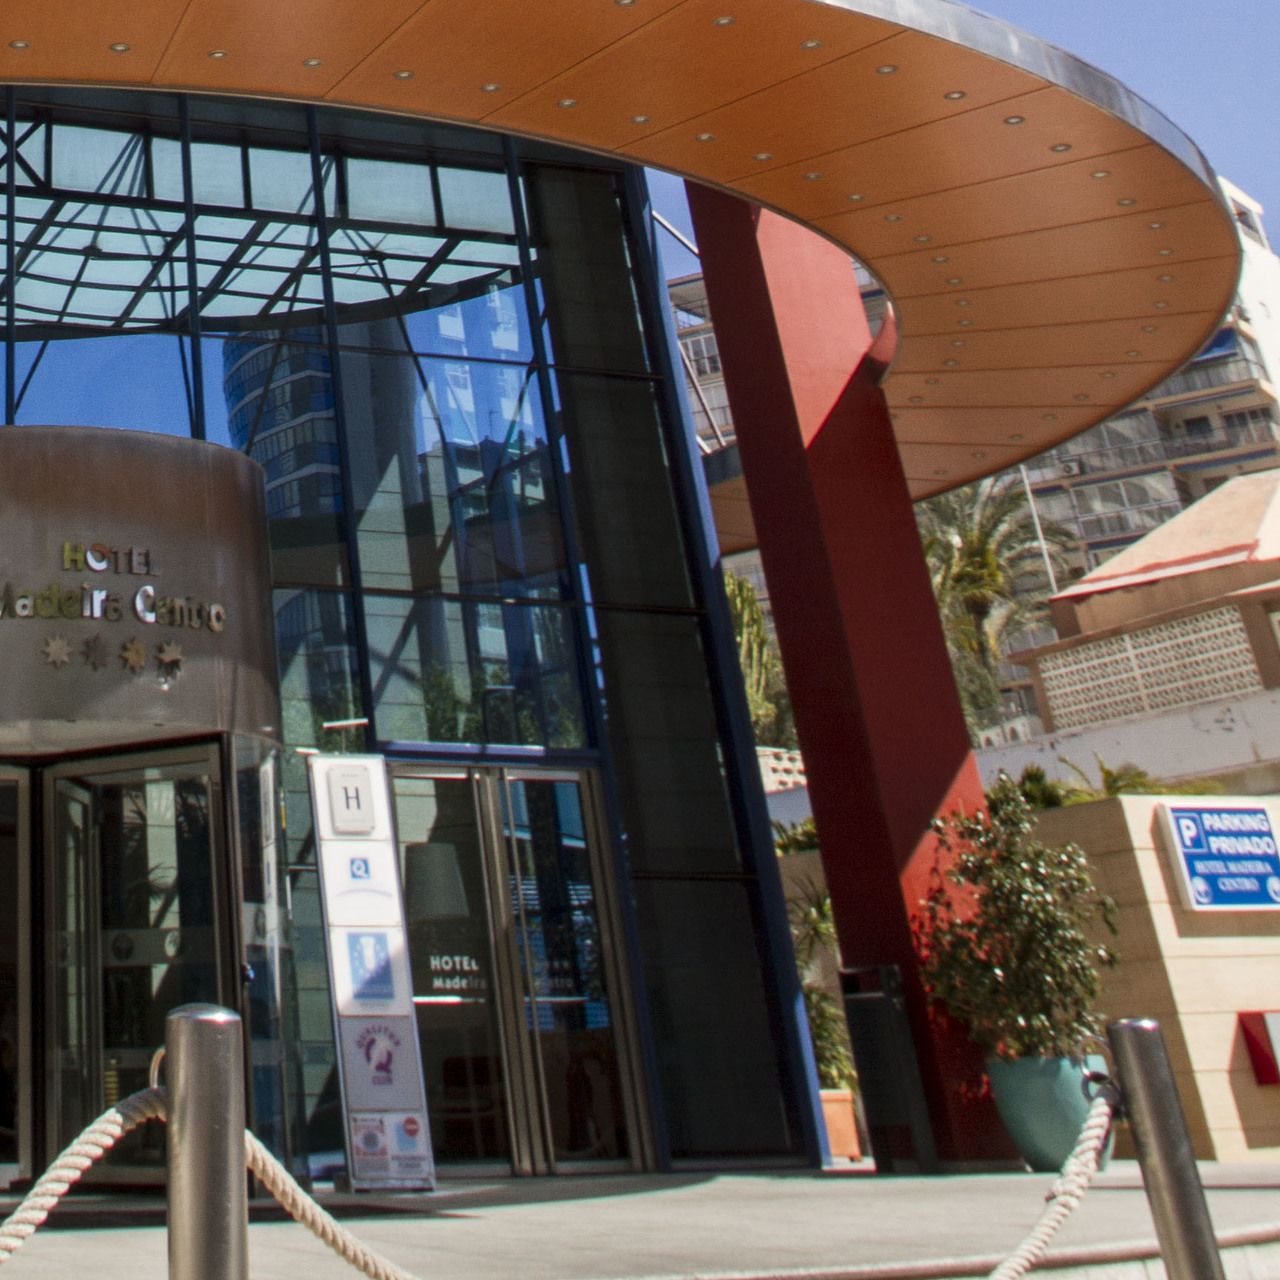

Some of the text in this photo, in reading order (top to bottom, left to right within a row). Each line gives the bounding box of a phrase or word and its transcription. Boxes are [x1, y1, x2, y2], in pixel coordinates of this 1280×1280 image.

[63, 542, 161, 576] HOTEL
[134, 585, 226, 632] Centro
[342, 786, 361, 810] H
[1179, 813, 1270, 848] P PARKING
[1207, 836, 1277, 855] PRIVADO
[429, 955, 479, 971] HOTEL
